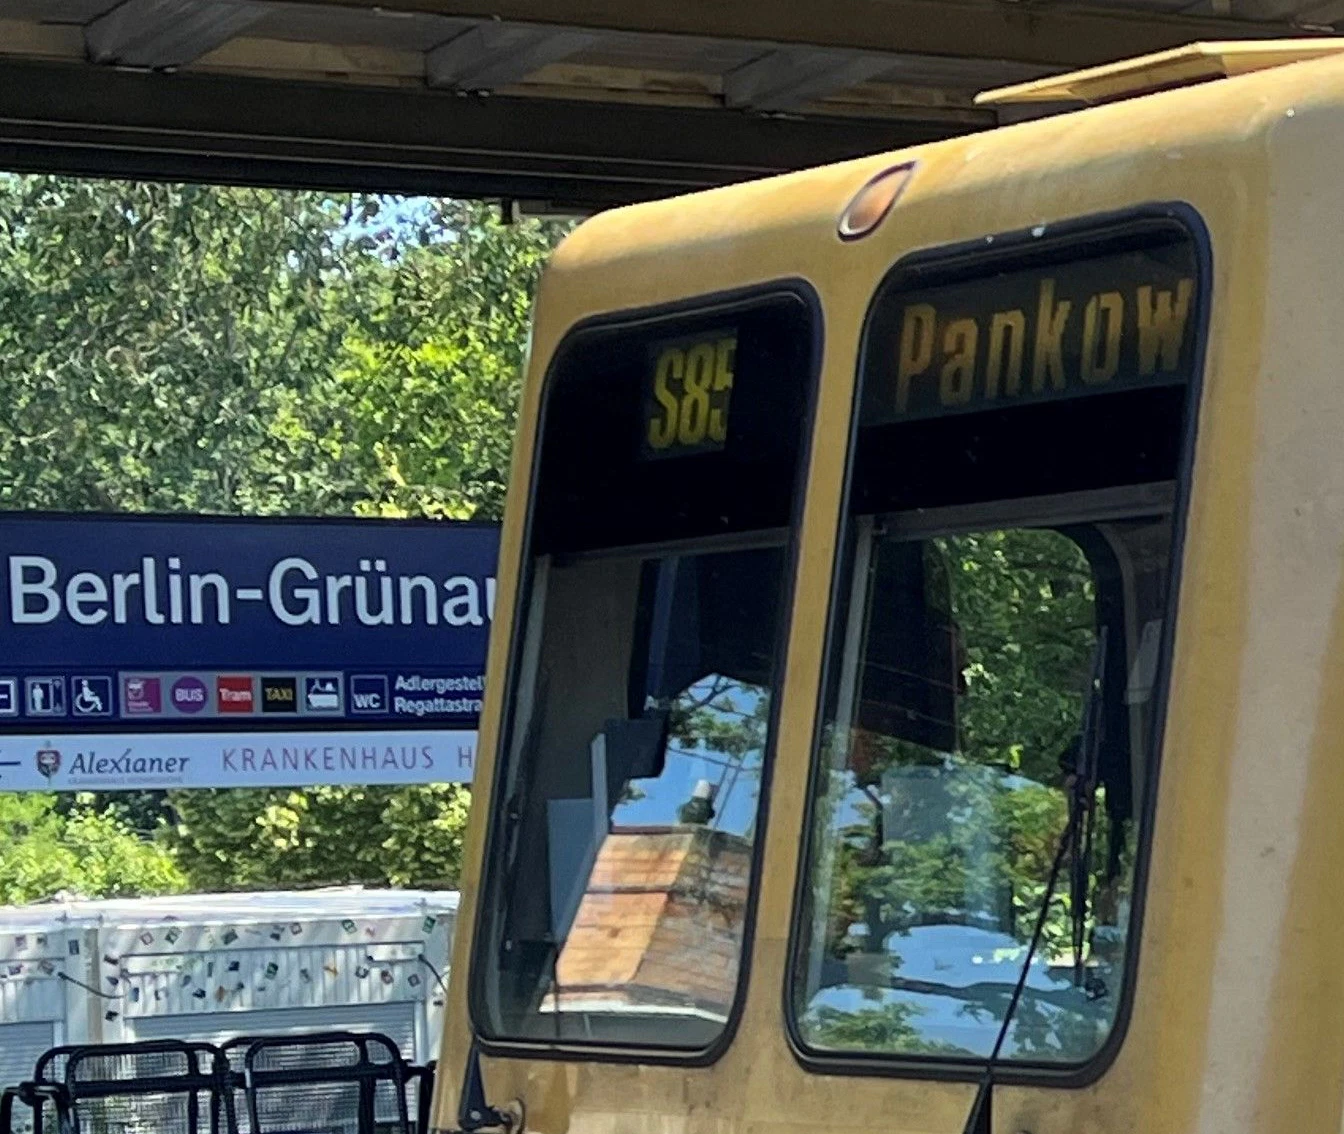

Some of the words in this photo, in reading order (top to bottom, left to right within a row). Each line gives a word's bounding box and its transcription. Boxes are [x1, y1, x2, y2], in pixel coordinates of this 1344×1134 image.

[894, 278, 1194, 413] Pankow
[219, 688, 252, 702] Tram
[264, 687, 294, 701] TAXI
[353, 694, 381, 709] WC
[68, 748, 190, 775] Alexianer
[222, 746, 434, 772] KRANKENHAUS
